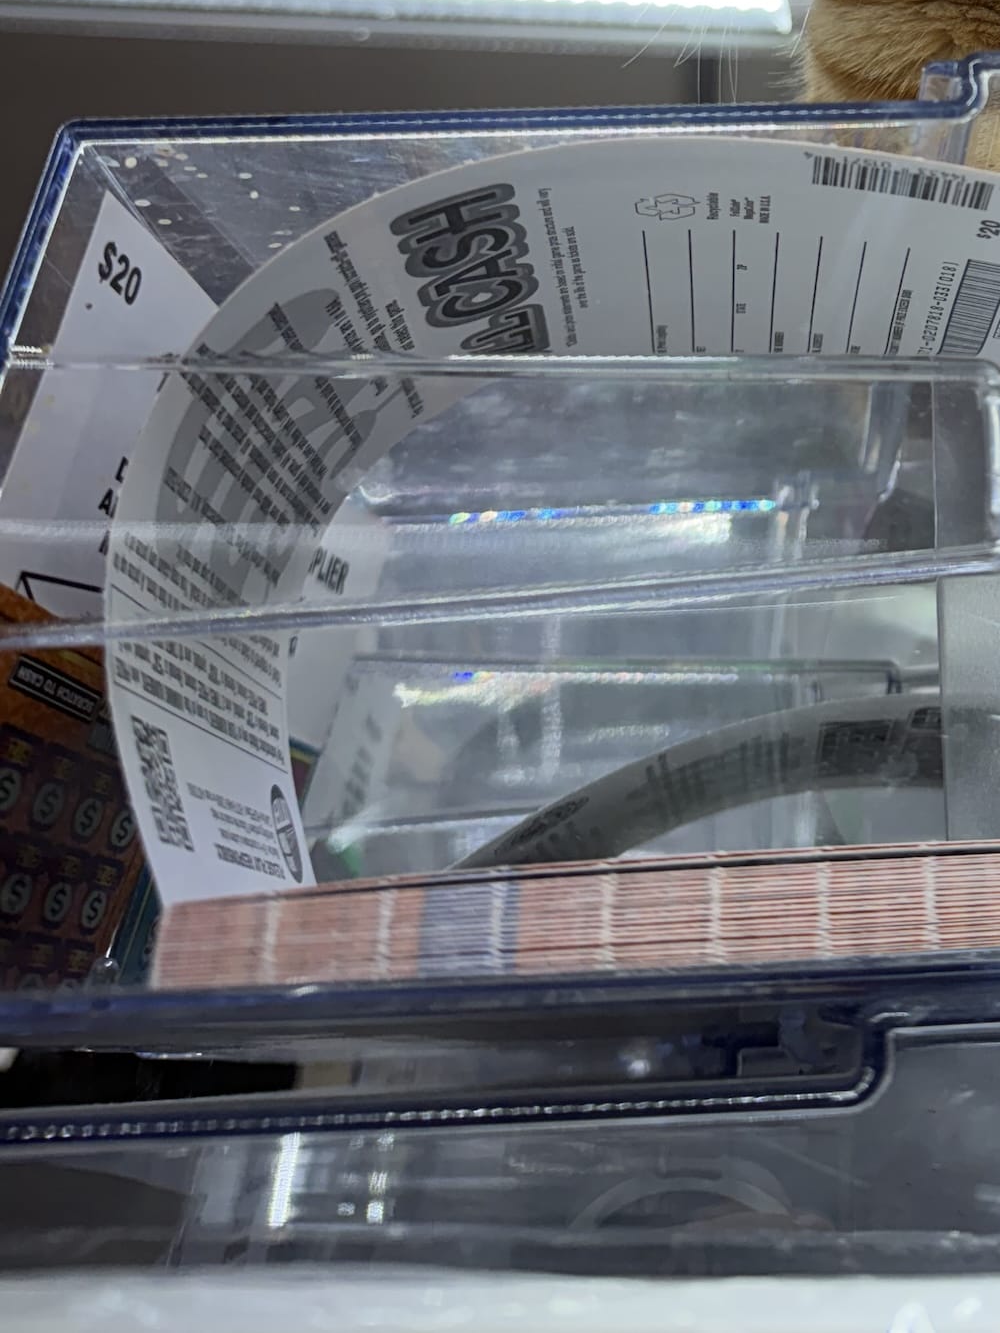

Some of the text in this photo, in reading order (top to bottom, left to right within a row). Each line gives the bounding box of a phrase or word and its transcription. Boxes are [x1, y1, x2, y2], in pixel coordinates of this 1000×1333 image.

[390, 182, 540, 328] CASH
[976, 219, 1000, 239] $20
[97, 241, 143, 306] $20
[17, 666, 93, 711] SCRATCH TO CASH
